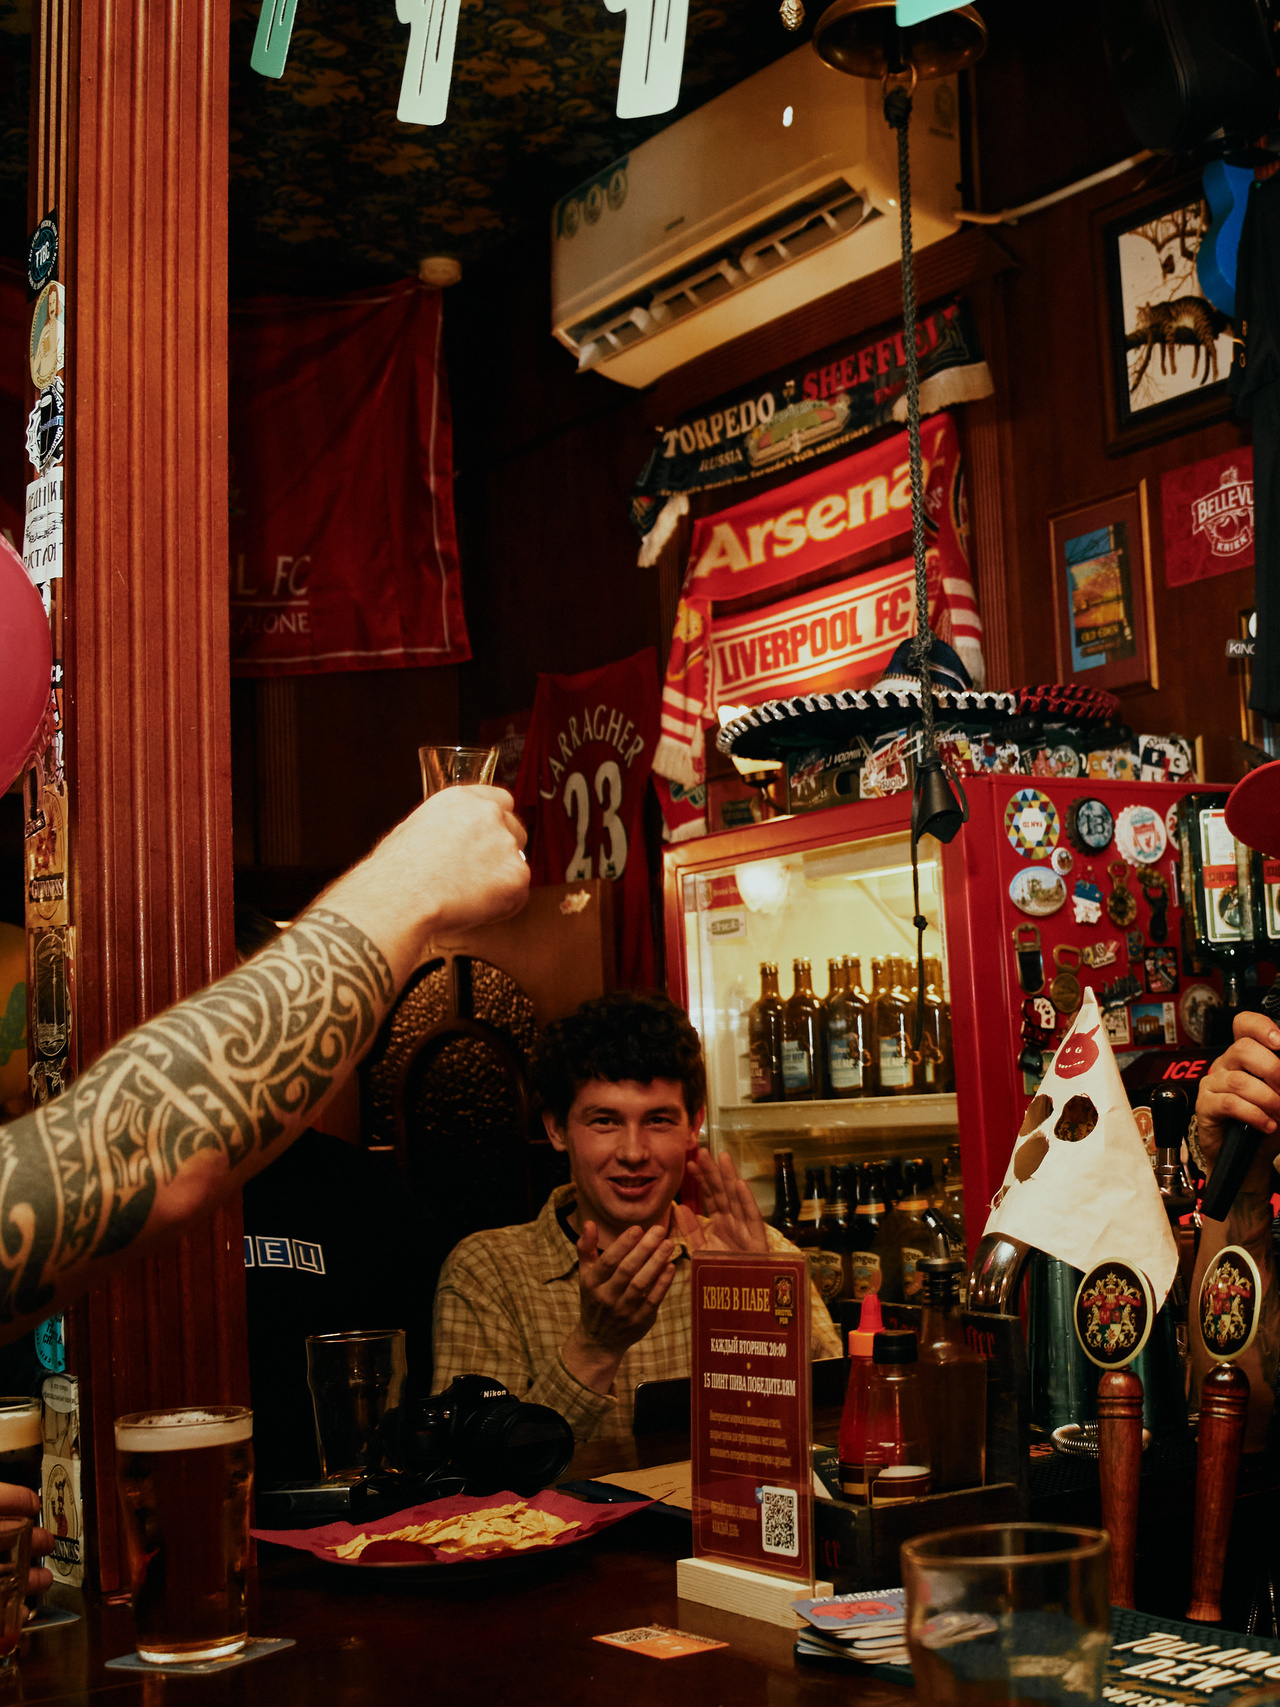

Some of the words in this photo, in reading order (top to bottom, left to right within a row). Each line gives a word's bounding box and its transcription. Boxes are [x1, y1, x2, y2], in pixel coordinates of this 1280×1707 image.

[661, 392, 776, 459] TORPEDO
[692, 450, 938, 578] Arsena
[1216, 533, 1248, 552] KRIEK
[273, 555, 312, 596] FC
[717, 606, 862, 686] LIVERPOOL
[875, 586, 912, 638] FC
[563, 760, 629, 883] 23
[31, 878, 64, 900] GUINNESS
[1162, 1060, 1208, 1080] ICE
[703, 1286, 731, 1310] КВИЗ
[732, 1287, 740, 1310] В
[741, 1287, 771, 1312] ПАБЕ
[710, 1335, 738, 1356] КАЖДЫЙ
[738, 1339, 769, 1356] ВТОРНИК
[769, 1341, 787, 1358] 20:00
[483, 1389, 507, 1399] Nikon
[703, 1372, 711, 1388] 15
[711, 1372, 729, 1390] ПИНТ
[729, 1374, 747, 1392] ПИВА
[747, 1375, 796, 1397] ПОБЕДИТЕЛЯМ
